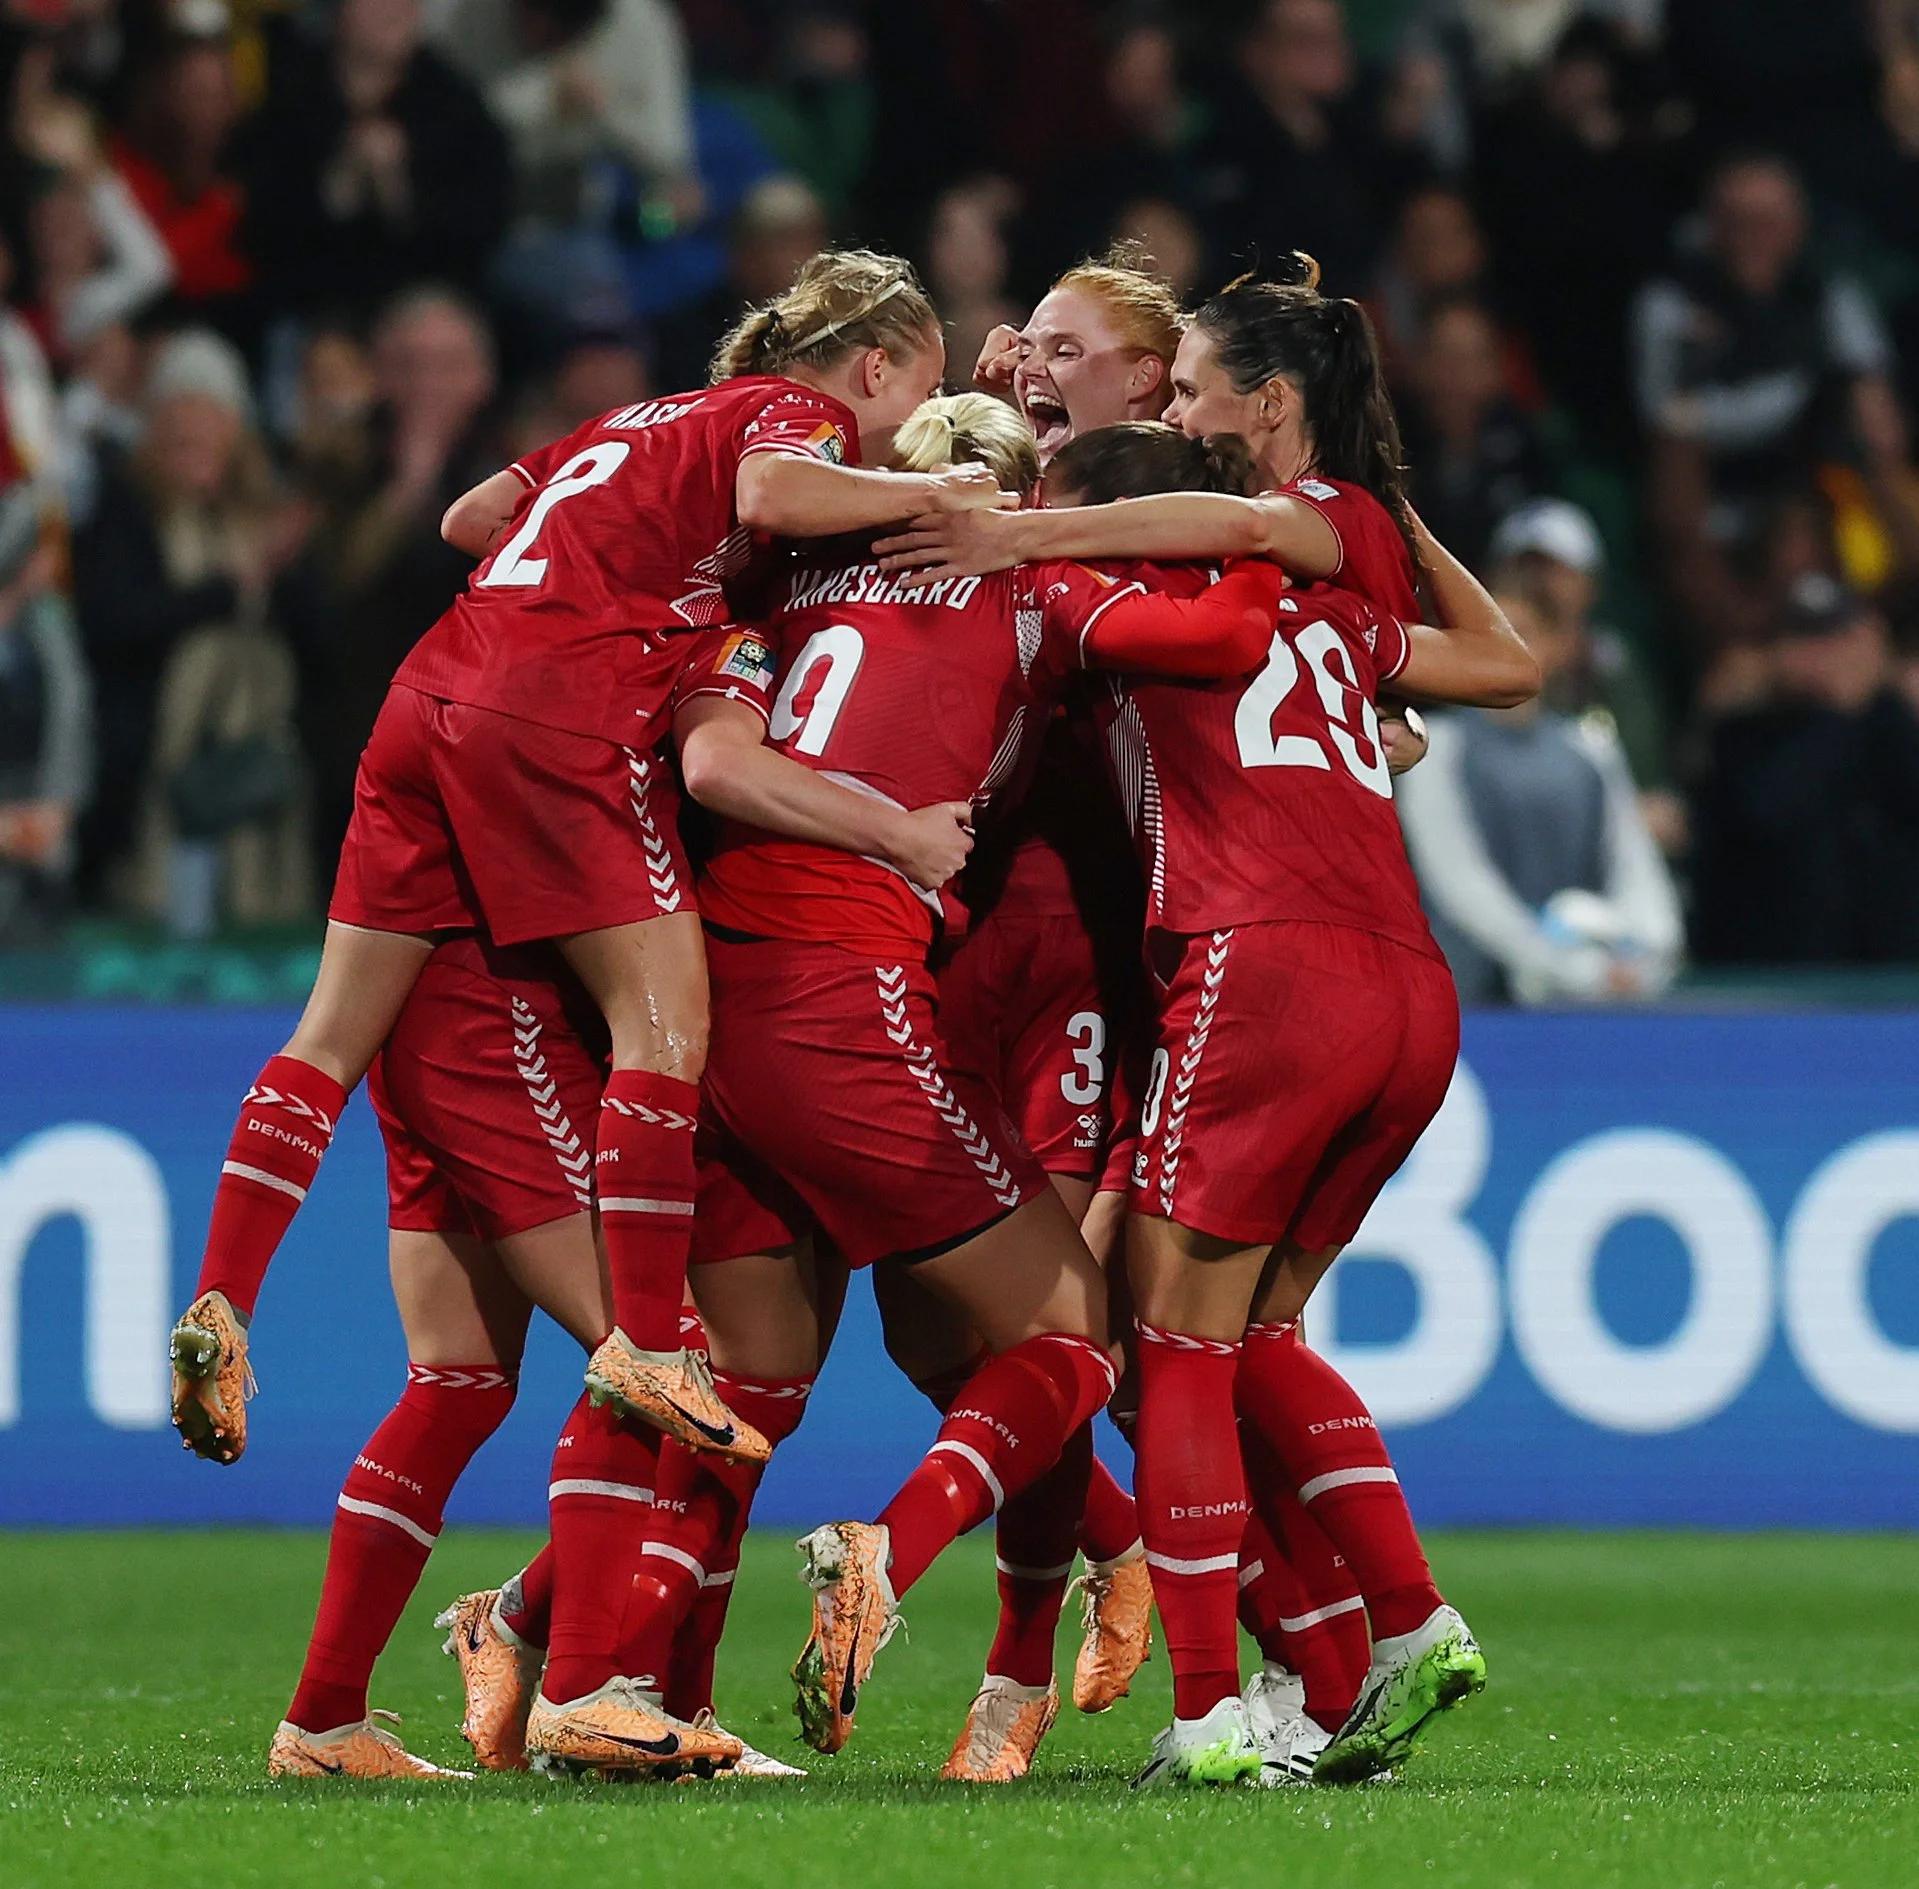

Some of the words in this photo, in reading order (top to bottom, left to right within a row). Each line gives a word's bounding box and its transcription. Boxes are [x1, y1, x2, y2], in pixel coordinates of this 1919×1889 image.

[475, 441, 631, 587] 2
[769, 624, 866, 757] 9
[1061, 1011, 1106, 1105] 3
